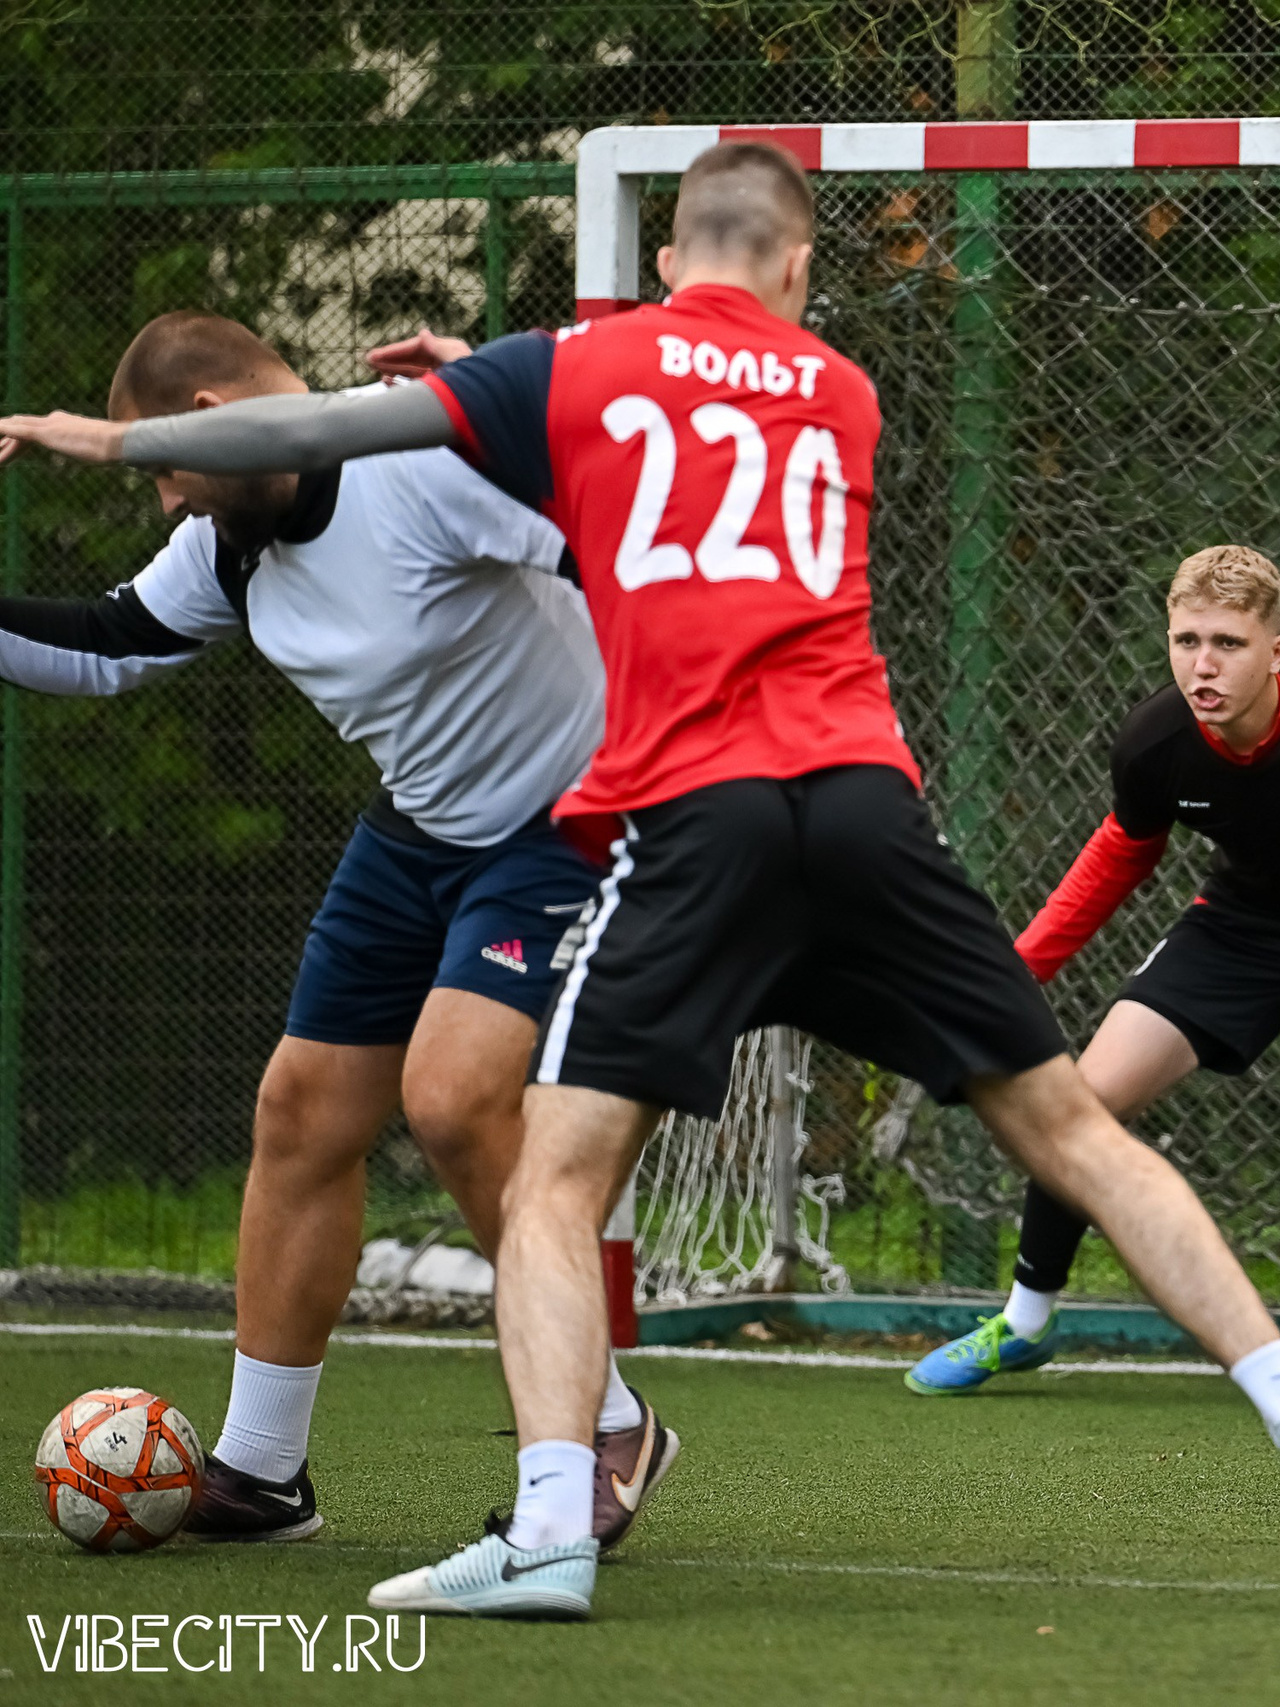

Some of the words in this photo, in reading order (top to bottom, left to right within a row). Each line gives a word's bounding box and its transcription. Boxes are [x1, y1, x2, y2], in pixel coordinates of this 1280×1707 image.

[656, 333, 827, 400] ВОЛЬТ
[600, 394, 850, 600] 220
[112, 1431, 128, 1445] 4
